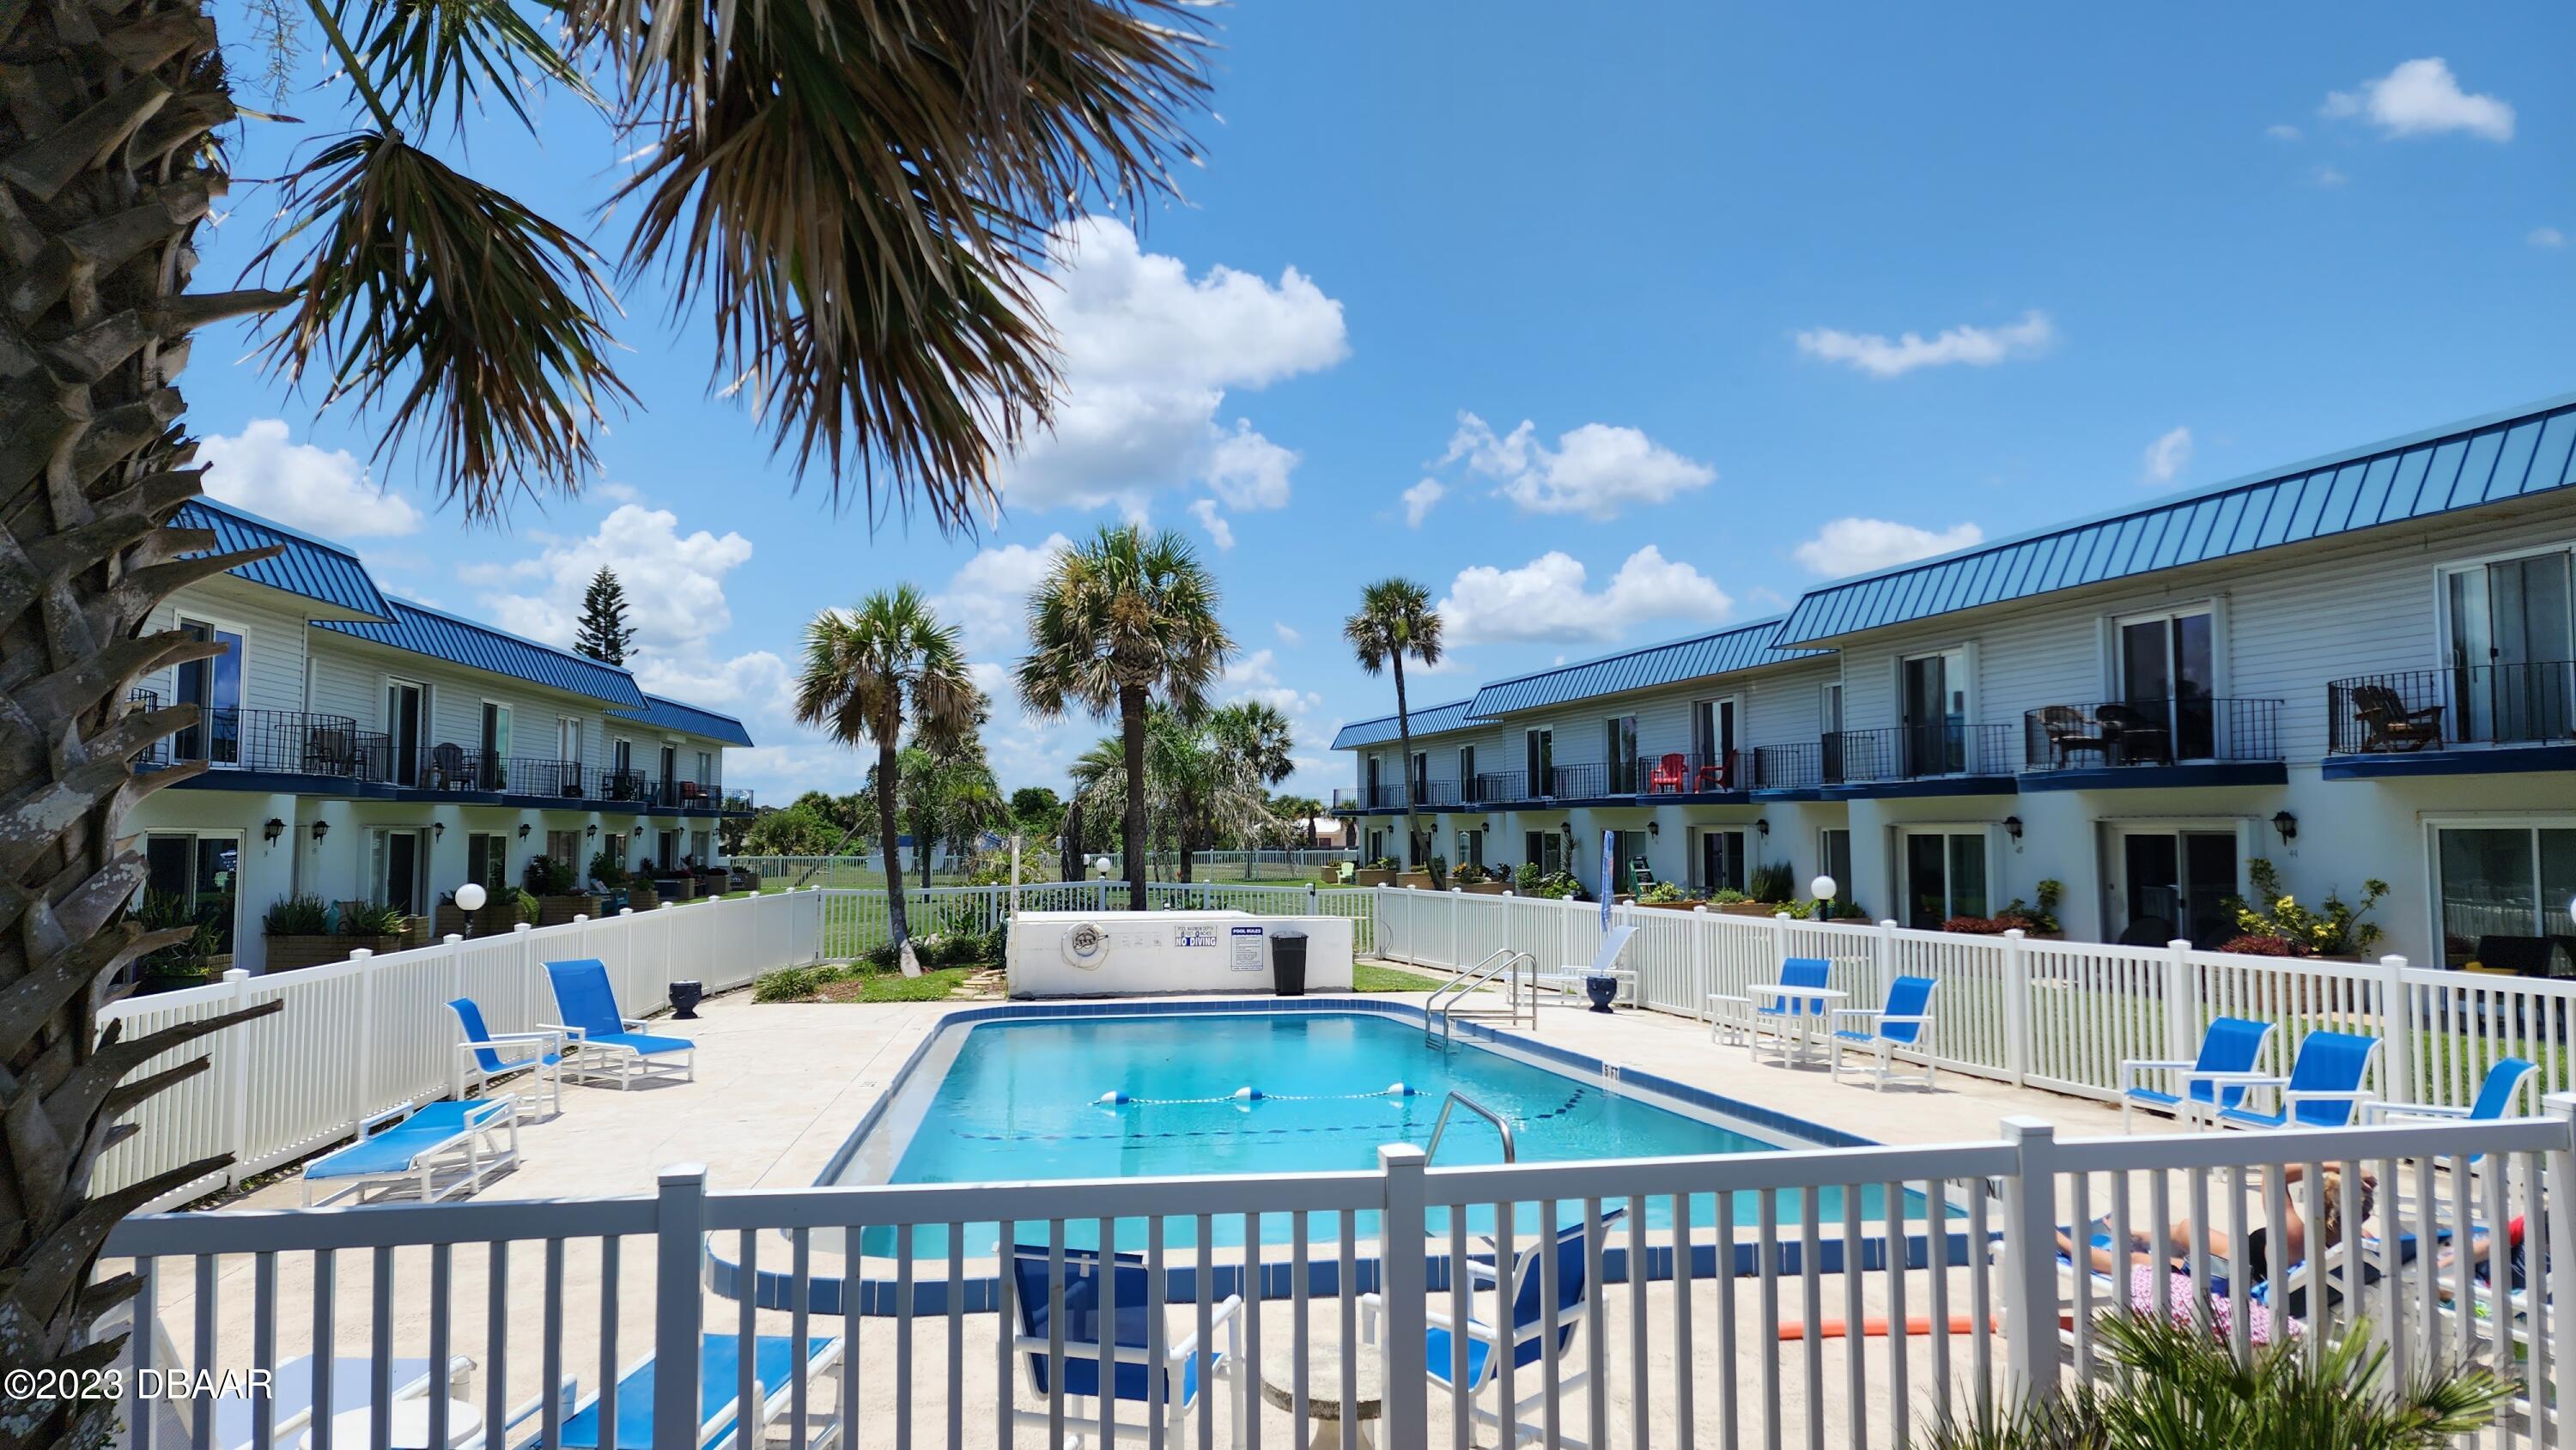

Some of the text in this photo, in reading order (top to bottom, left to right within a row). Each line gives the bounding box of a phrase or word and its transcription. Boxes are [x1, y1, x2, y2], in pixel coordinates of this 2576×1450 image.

[1176, 937, 1216, 945] NO DIVING
[1604, 1065, 1618, 1081] 5 FT
